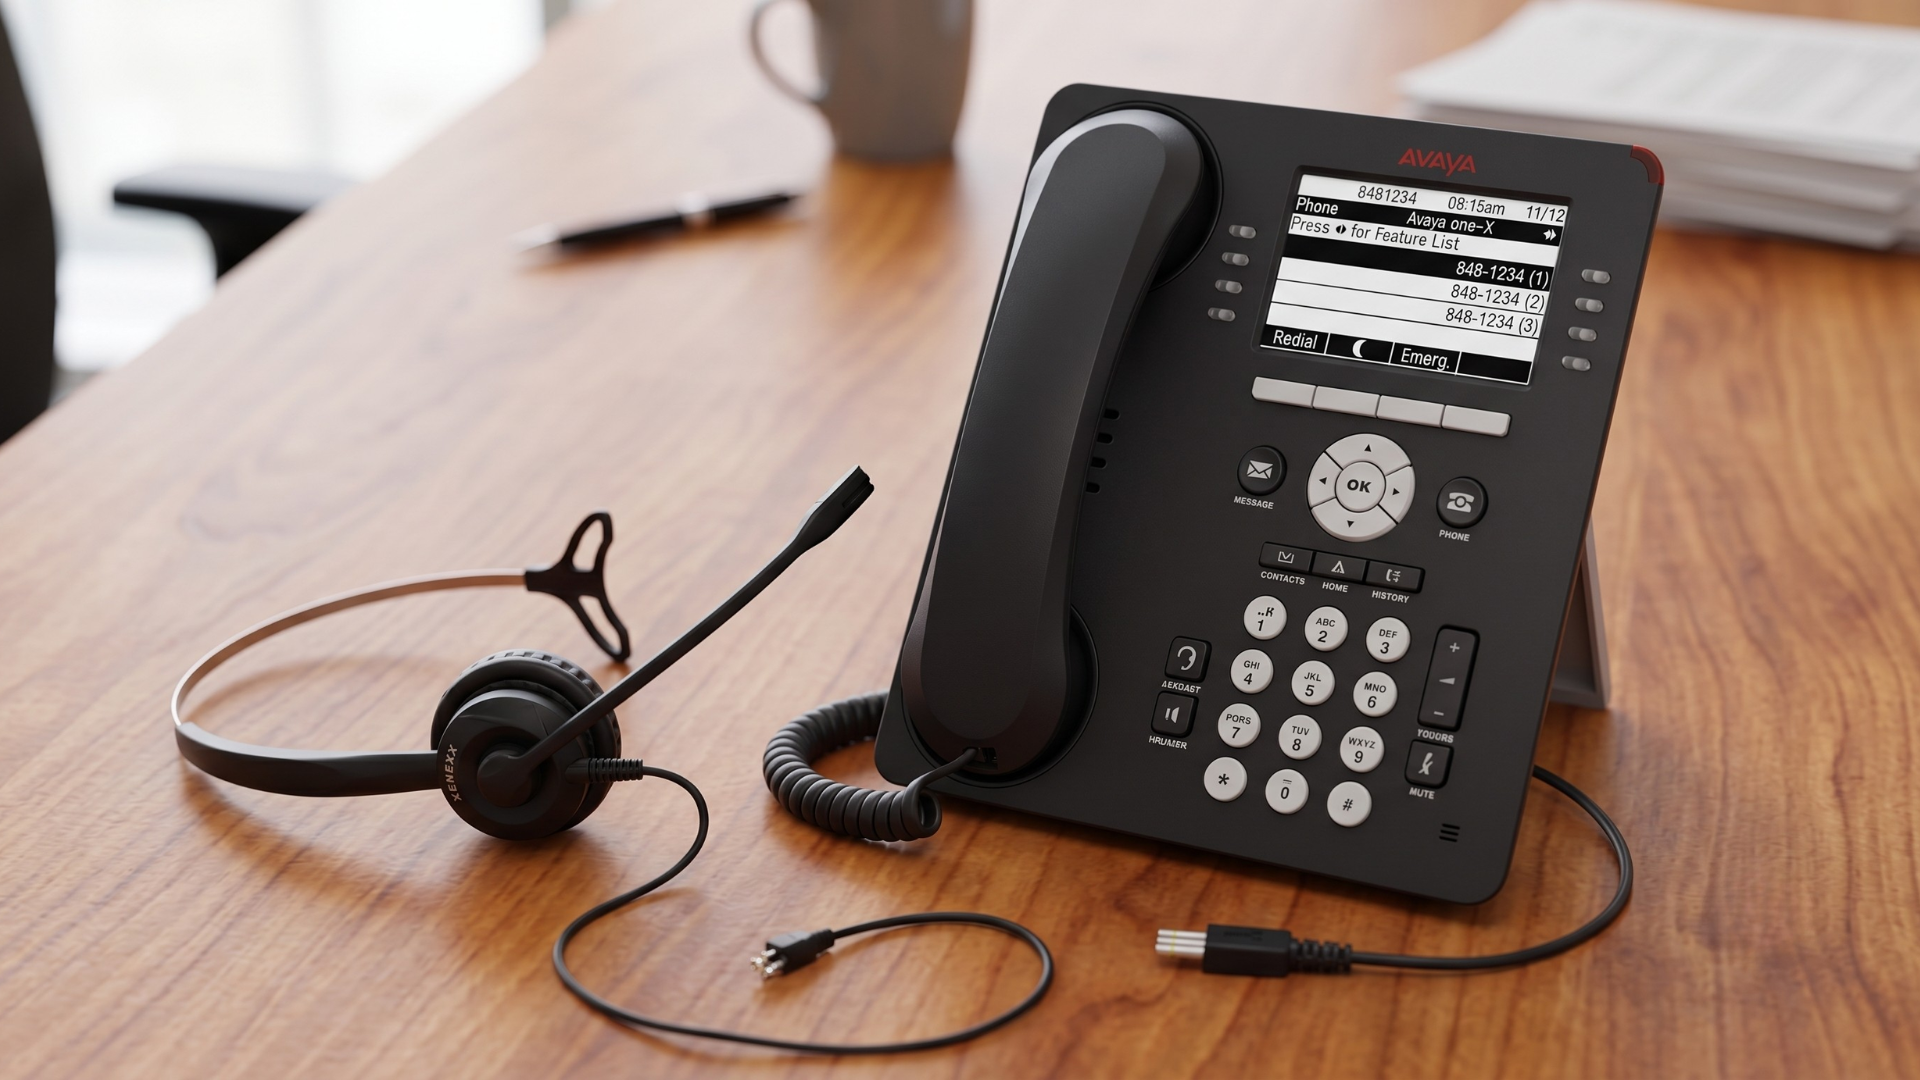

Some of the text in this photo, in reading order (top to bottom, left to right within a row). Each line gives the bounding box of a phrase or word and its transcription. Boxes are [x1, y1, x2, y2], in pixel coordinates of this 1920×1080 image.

[1398, 148, 1476, 176] AVAYA
[1295, 196, 1339, 216] Phone
[1357, 185, 1566, 223] 8481234 08:15am 11/12
[1406, 211, 1496, 235] Avaya one-X
[1290, 215, 1460, 251] Press for Feature List
[1456, 260, 1549, 290] 848-1234 (1)
[1450, 283, 1545, 314] 848-1234 (2)
[1445, 307, 1539, 337] 848-1234 (3)
[1272, 329, 1318, 351] Redial
[1400, 348, 1450, 370] Emerg.
[1347, 479, 1371, 494] OK
[1233, 495, 1274, 510] MESSAGE
[1439, 529, 1470, 542] PHONE
[1260, 570, 1305, 585] CONTACTS
[1322, 581, 1348, 593] HOME
[1371, 590, 1410, 604] HISTORY
[1257, 619, 1264, 632] 1
[1315, 617, 1336, 628] ABC
[1317, 630, 1328, 643] 2
[1379, 629, 1398, 639] DEF
[1380, 641, 1390, 655] 3
[1243, 660, 1260, 670] GHI
[1243, 673, 1253, 685] 4
[1304, 672, 1322, 682] JKL
[1304, 684, 1315, 697] 5
[1364, 682, 1387, 693] MNO
[1367, 695, 1377, 709] 6
[1231, 726, 1241, 739] 7
[1292, 725, 1310, 736] TUV
[1292, 738, 1302, 751] 8
[1348, 737, 1376, 749] WXYZ
[1354, 750, 1364, 764] 9
[444, 744, 462, 802] XENEXX
[1280, 786, 1290, 800] 0
[1409, 787, 1435, 800] MUTE
